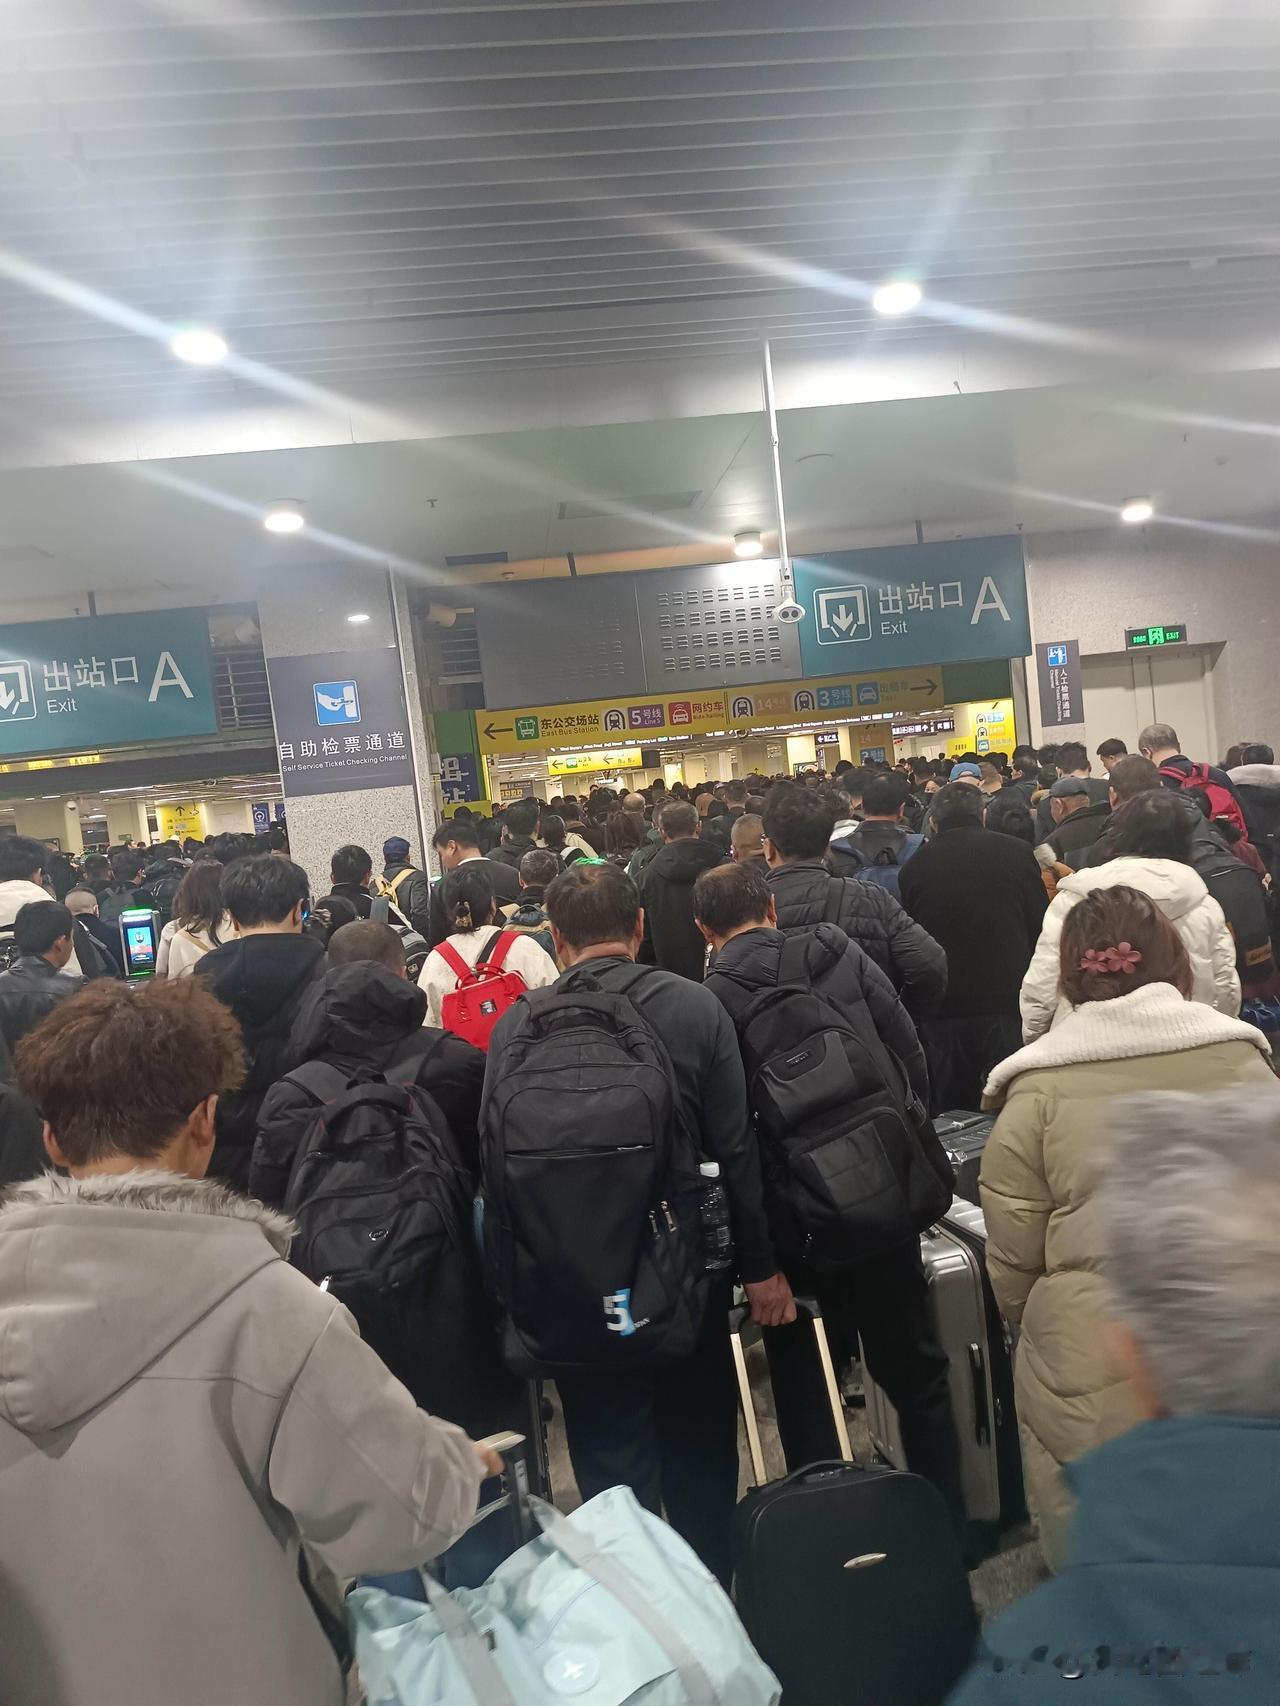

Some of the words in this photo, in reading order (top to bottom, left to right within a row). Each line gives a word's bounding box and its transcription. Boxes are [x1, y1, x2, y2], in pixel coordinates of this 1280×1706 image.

[878, 581, 963, 615] 出站口
[970, 576, 1011, 625] A
[880, 621, 907, 635] Exit
[43, 656, 139, 692] 出站口
[148, 651, 194, 702] A
[47, 698, 77, 713] Exit
[819, 689, 851, 706] 3号线
[692, 702, 724, 713] 网约车
[541, 714, 599, 730] 东公交场站
[631, 708, 662, 725] 5号线
[541, 729, 557, 737] East
[559, 728, 572, 736] Bus
[574, 726, 599, 735] Station
[280, 731, 406, 760] 自助检票通道
[282, 764, 296, 772] Self
[297, 761, 324, 771] Service
[325, 758, 346, 768] Ticket
[346, 755, 378, 766] Checking
[379, 752, 408, 762] Channel
